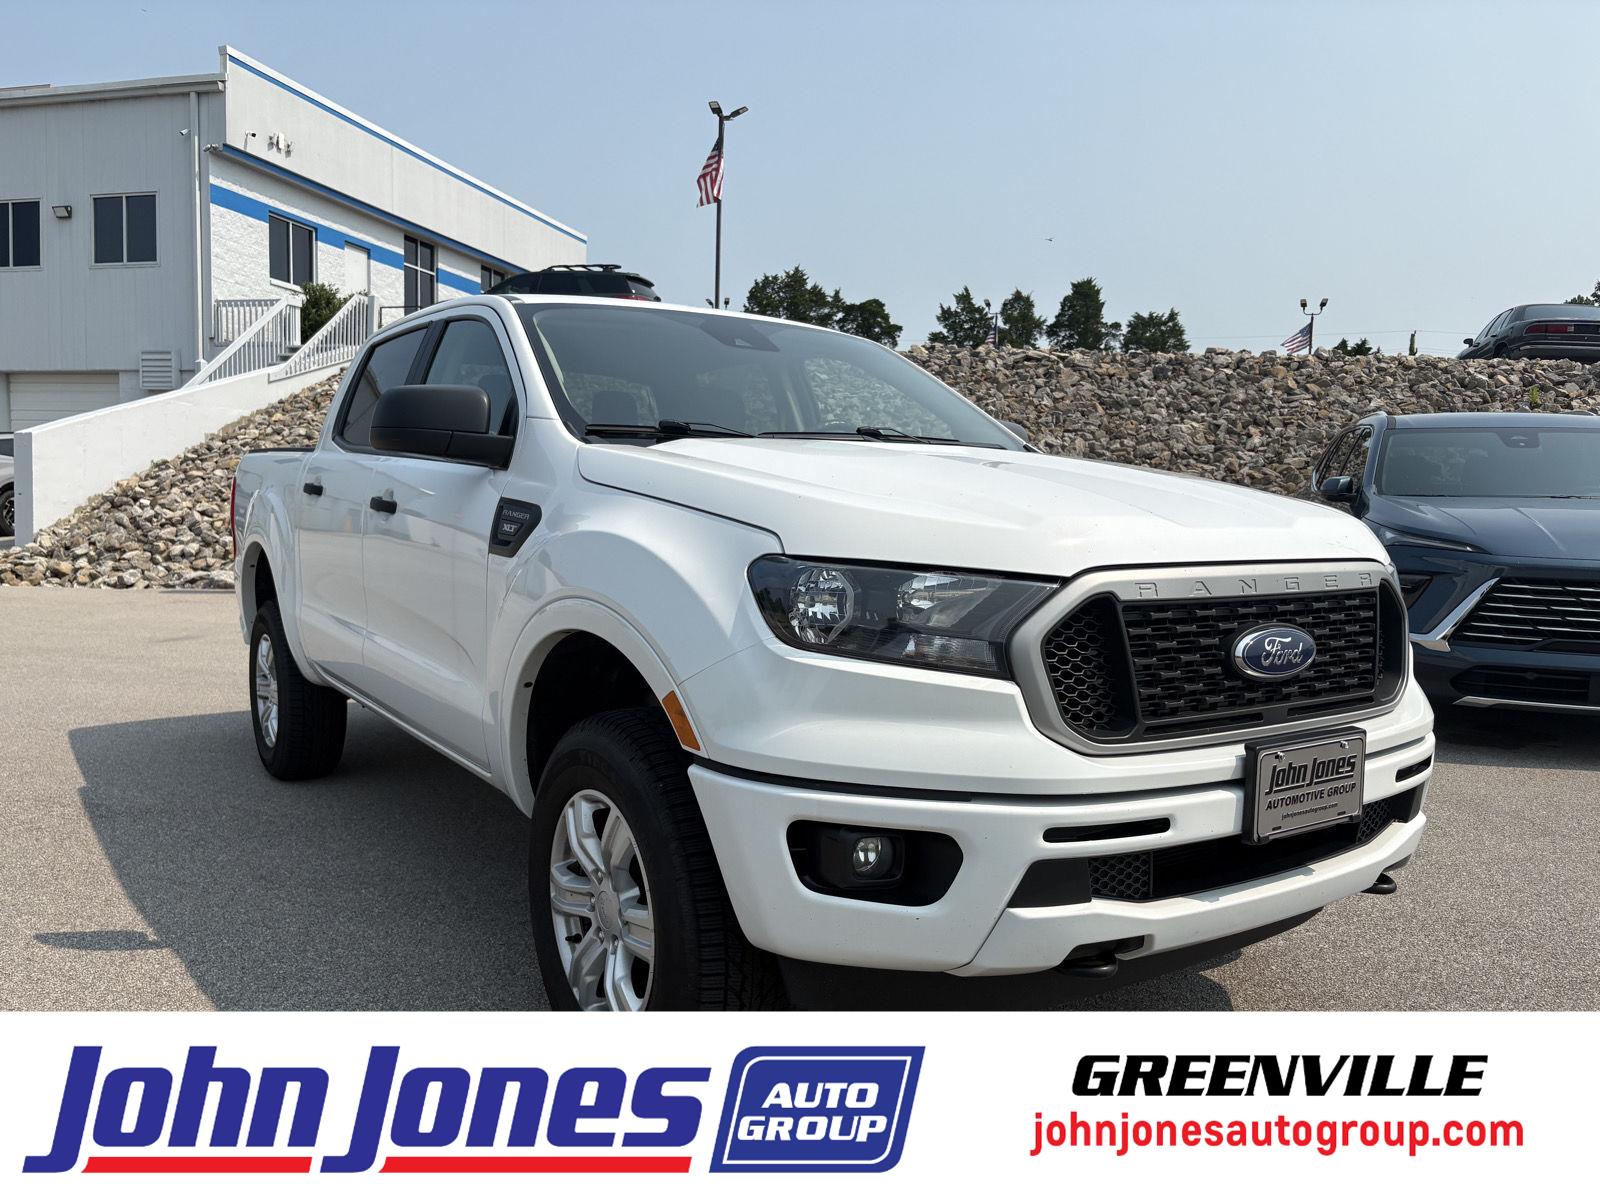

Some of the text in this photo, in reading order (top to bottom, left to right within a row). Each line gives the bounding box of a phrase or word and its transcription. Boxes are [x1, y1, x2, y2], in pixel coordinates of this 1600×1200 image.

[502, 509, 530, 520] RANGER
[502, 523, 518, 532] XLT
[1134, 571, 1374, 598] RANGER
[1261, 636, 1303, 667] Ford
[1265, 754, 1358, 796] John Jones
[1265, 782, 1357, 811] AUTOMOTIVE GROUP
